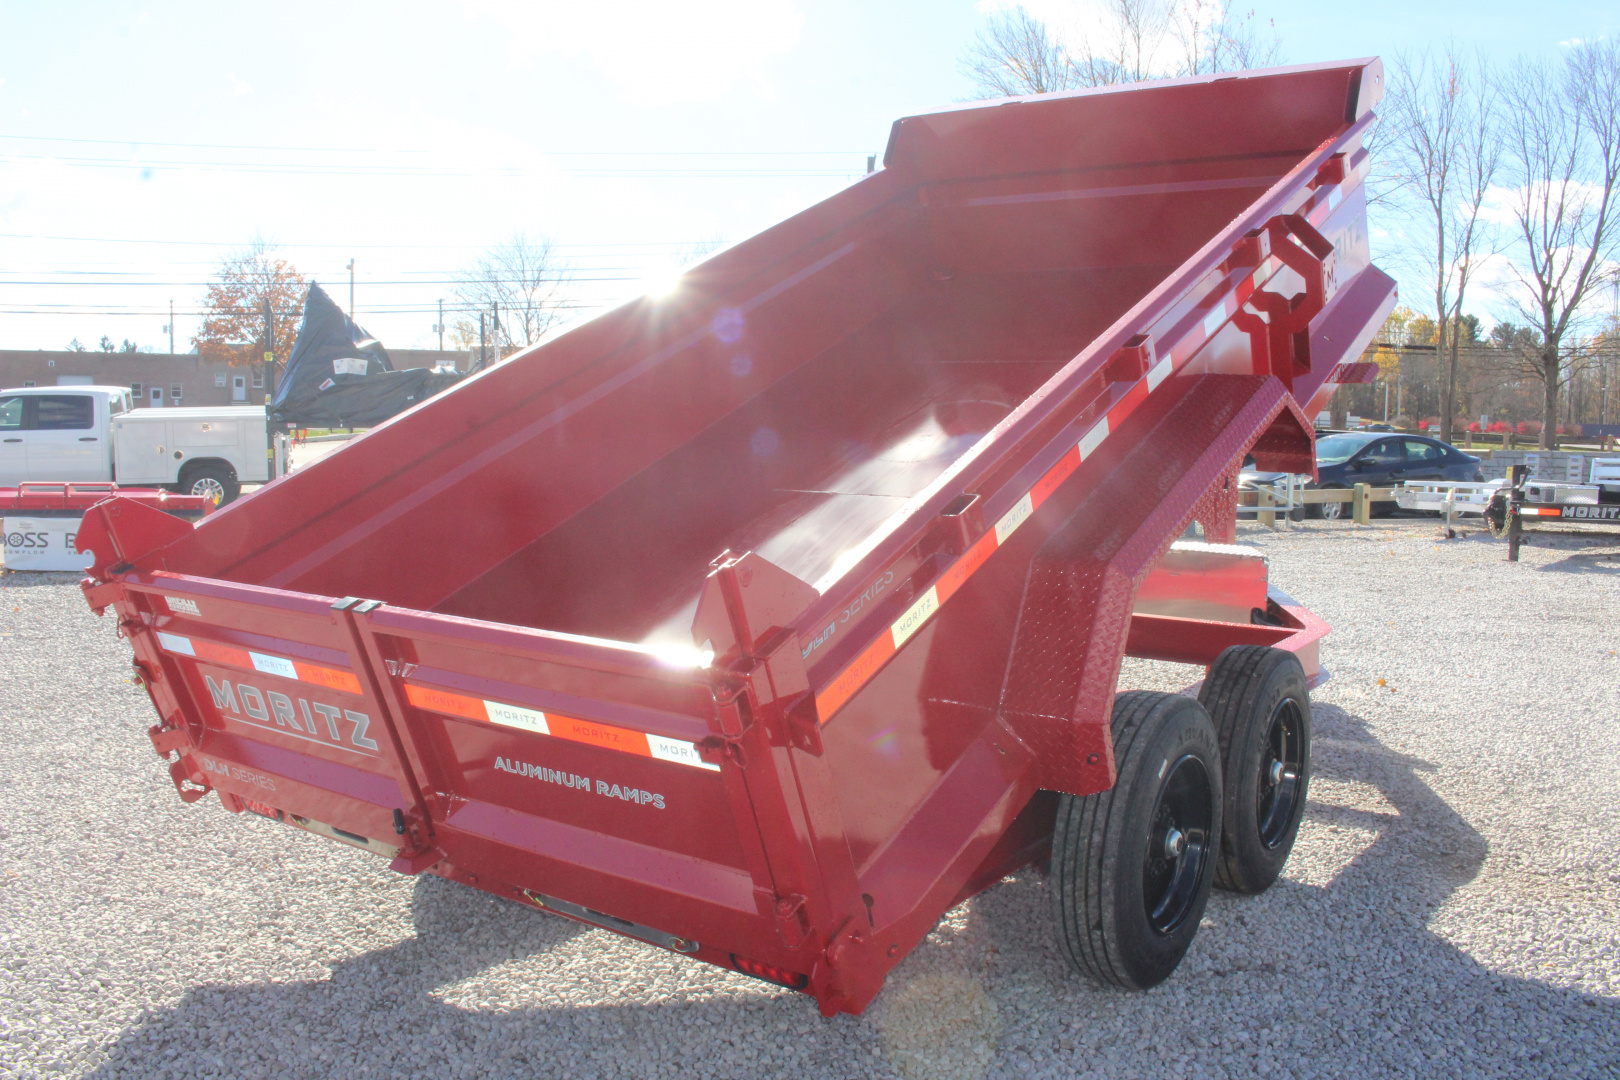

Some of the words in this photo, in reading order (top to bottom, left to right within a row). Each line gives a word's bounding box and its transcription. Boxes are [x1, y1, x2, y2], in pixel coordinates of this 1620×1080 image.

[1001, 503, 1028, 533] MORITZ
[1561, 506, 1620, 519] MORIT
[900, 598, 932, 634] MORITZ
[258, 658, 289, 672] MORITZ
[312, 669, 346, 685] MORITZ
[839, 654, 874, 694] MORITZ
[205, 675, 379, 751] MORITZ
[494, 708, 538, 725] MORITZ
[572, 725, 620, 743] MORITZ
[204, 757, 230, 777] DLH
[231, 764, 276, 791] SERIES
[494, 756, 591, 791] ALUMINUM
[596, 780, 666, 809] RAMPS
